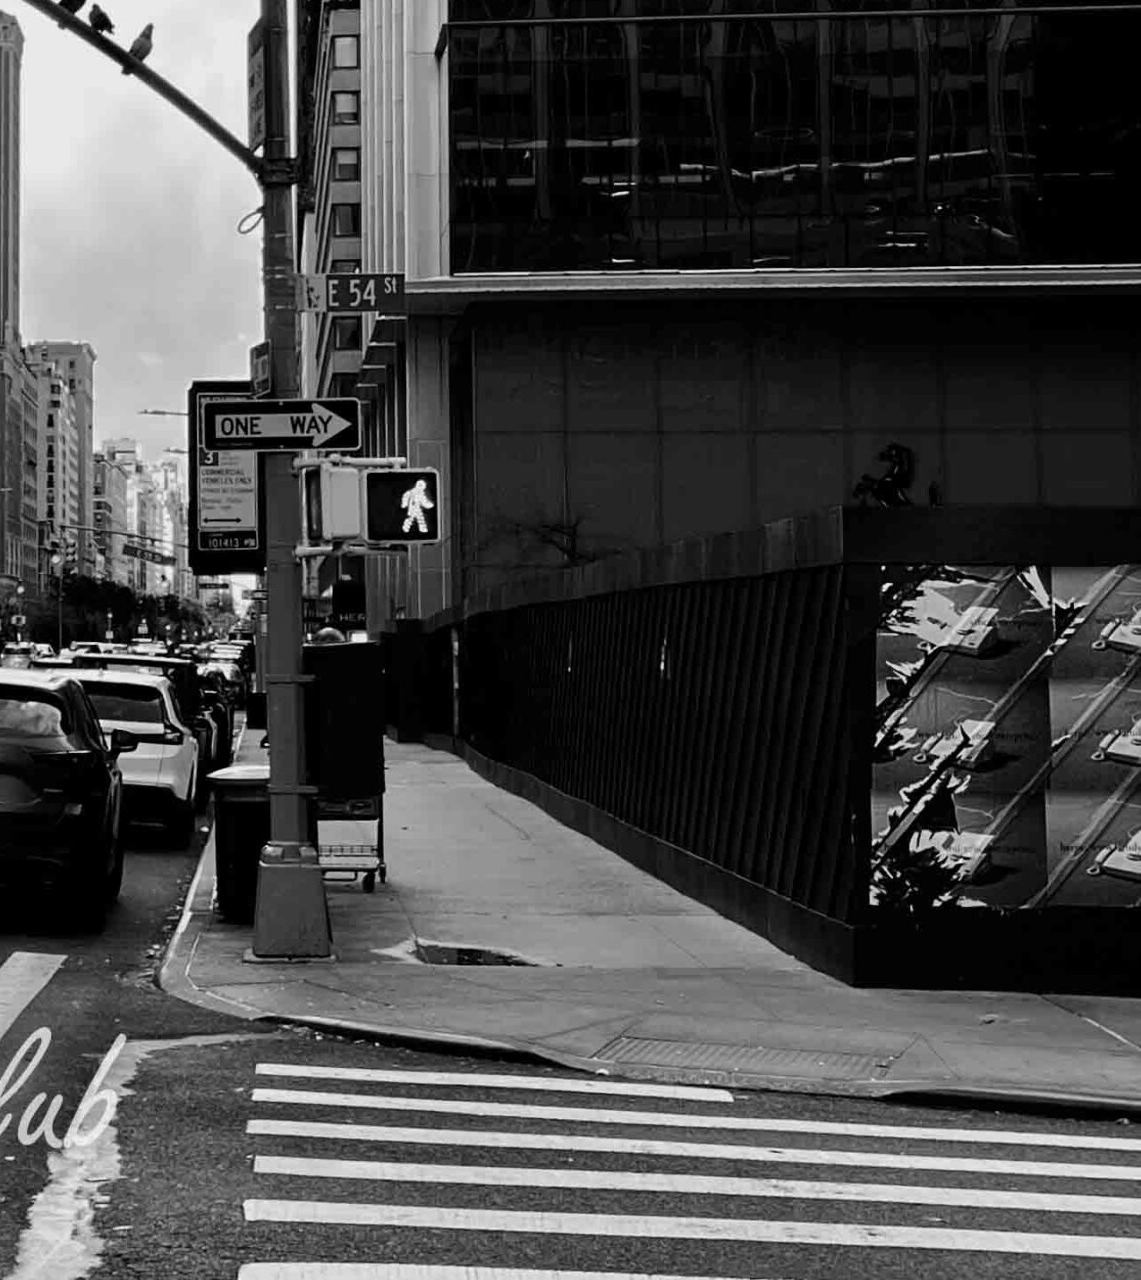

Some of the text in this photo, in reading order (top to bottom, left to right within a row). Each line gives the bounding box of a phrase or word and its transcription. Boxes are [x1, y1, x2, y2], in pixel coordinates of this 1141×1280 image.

[327, 276, 398, 308] E 54 St
[220, 415, 333, 436] ONE WAY
